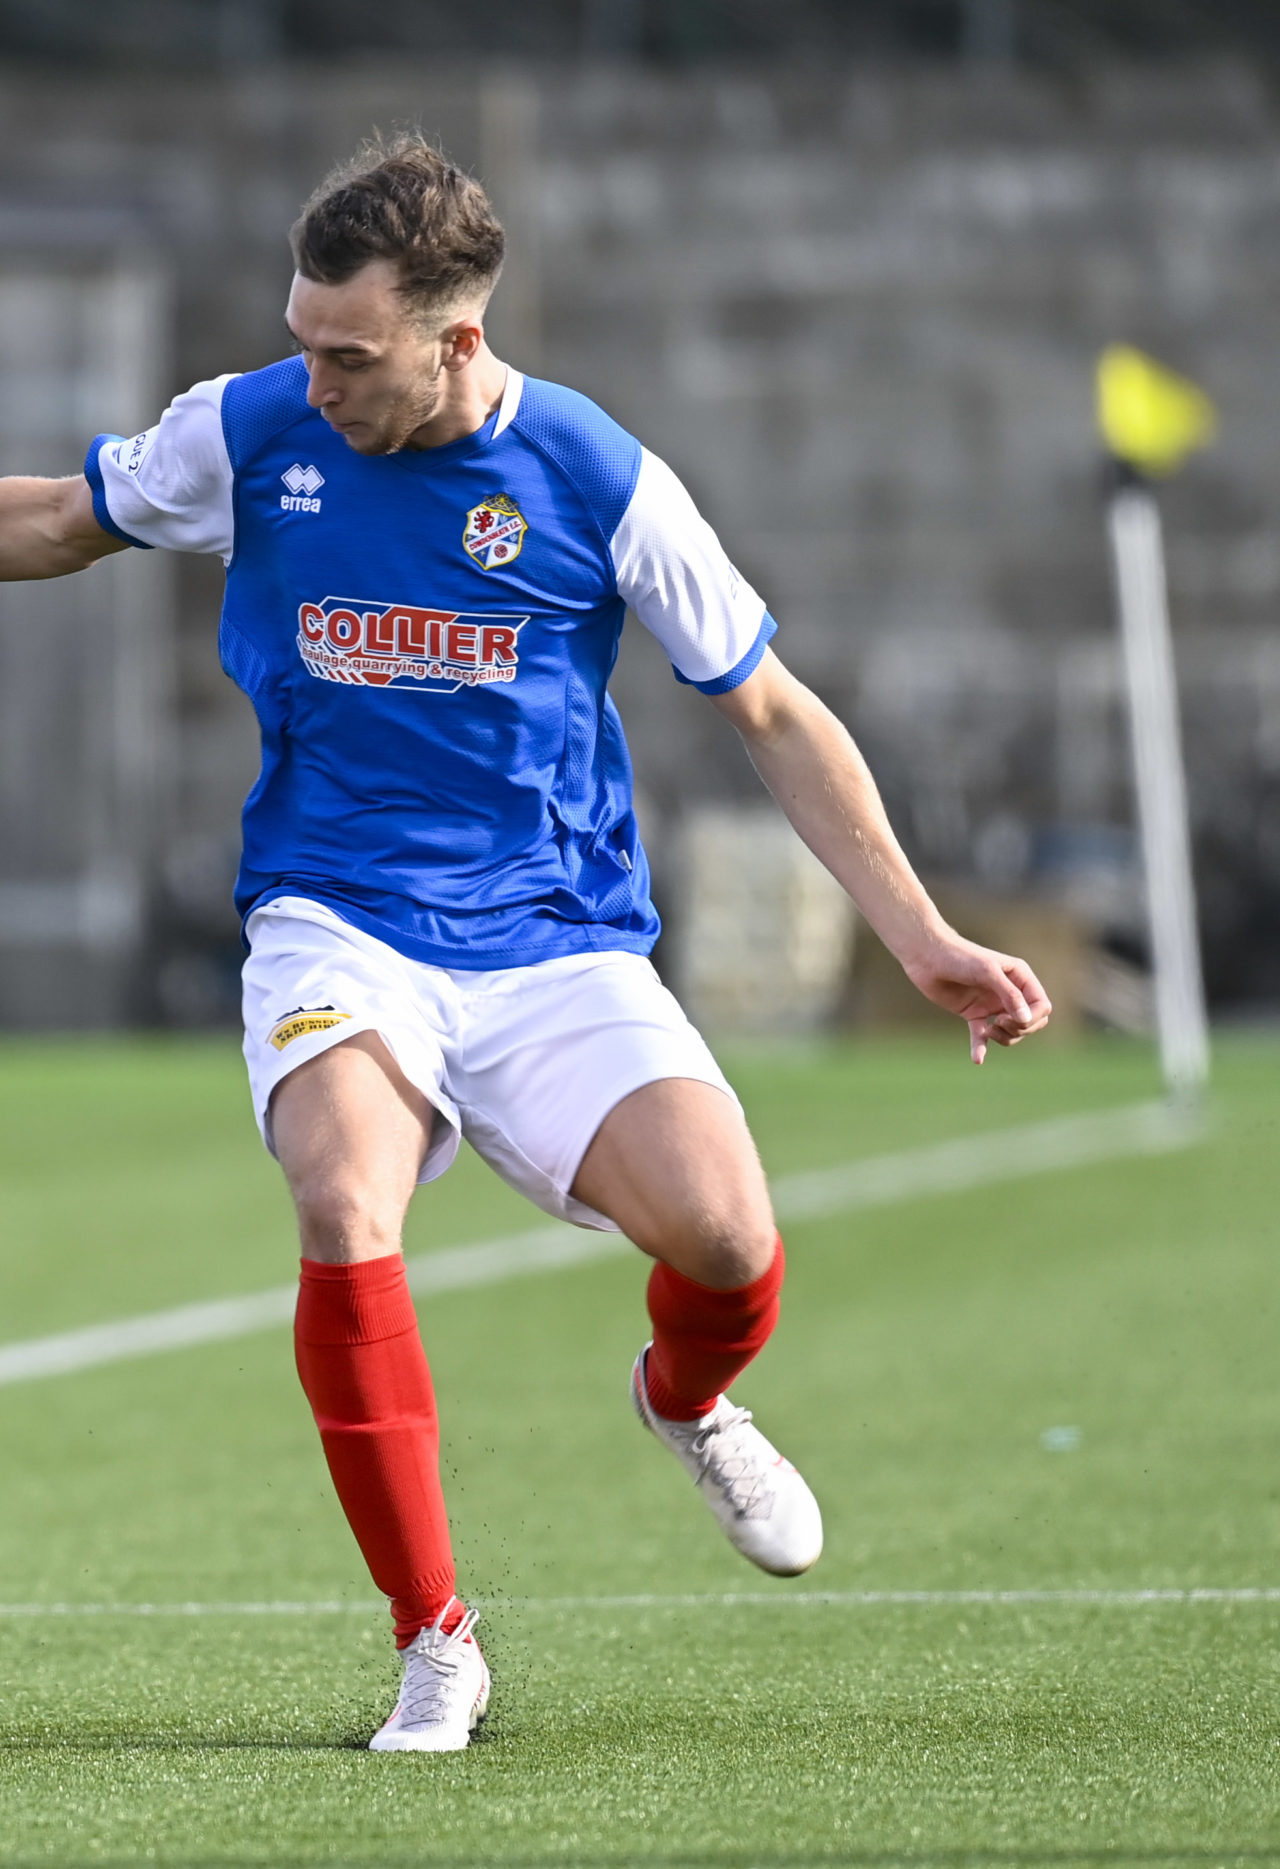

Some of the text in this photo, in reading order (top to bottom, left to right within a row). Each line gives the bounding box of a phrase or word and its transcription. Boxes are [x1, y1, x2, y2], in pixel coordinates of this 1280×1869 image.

[298, 603, 519, 667] COLLIER
[431, 663, 442, 675] &
[447, 667, 514, 682] recycling
